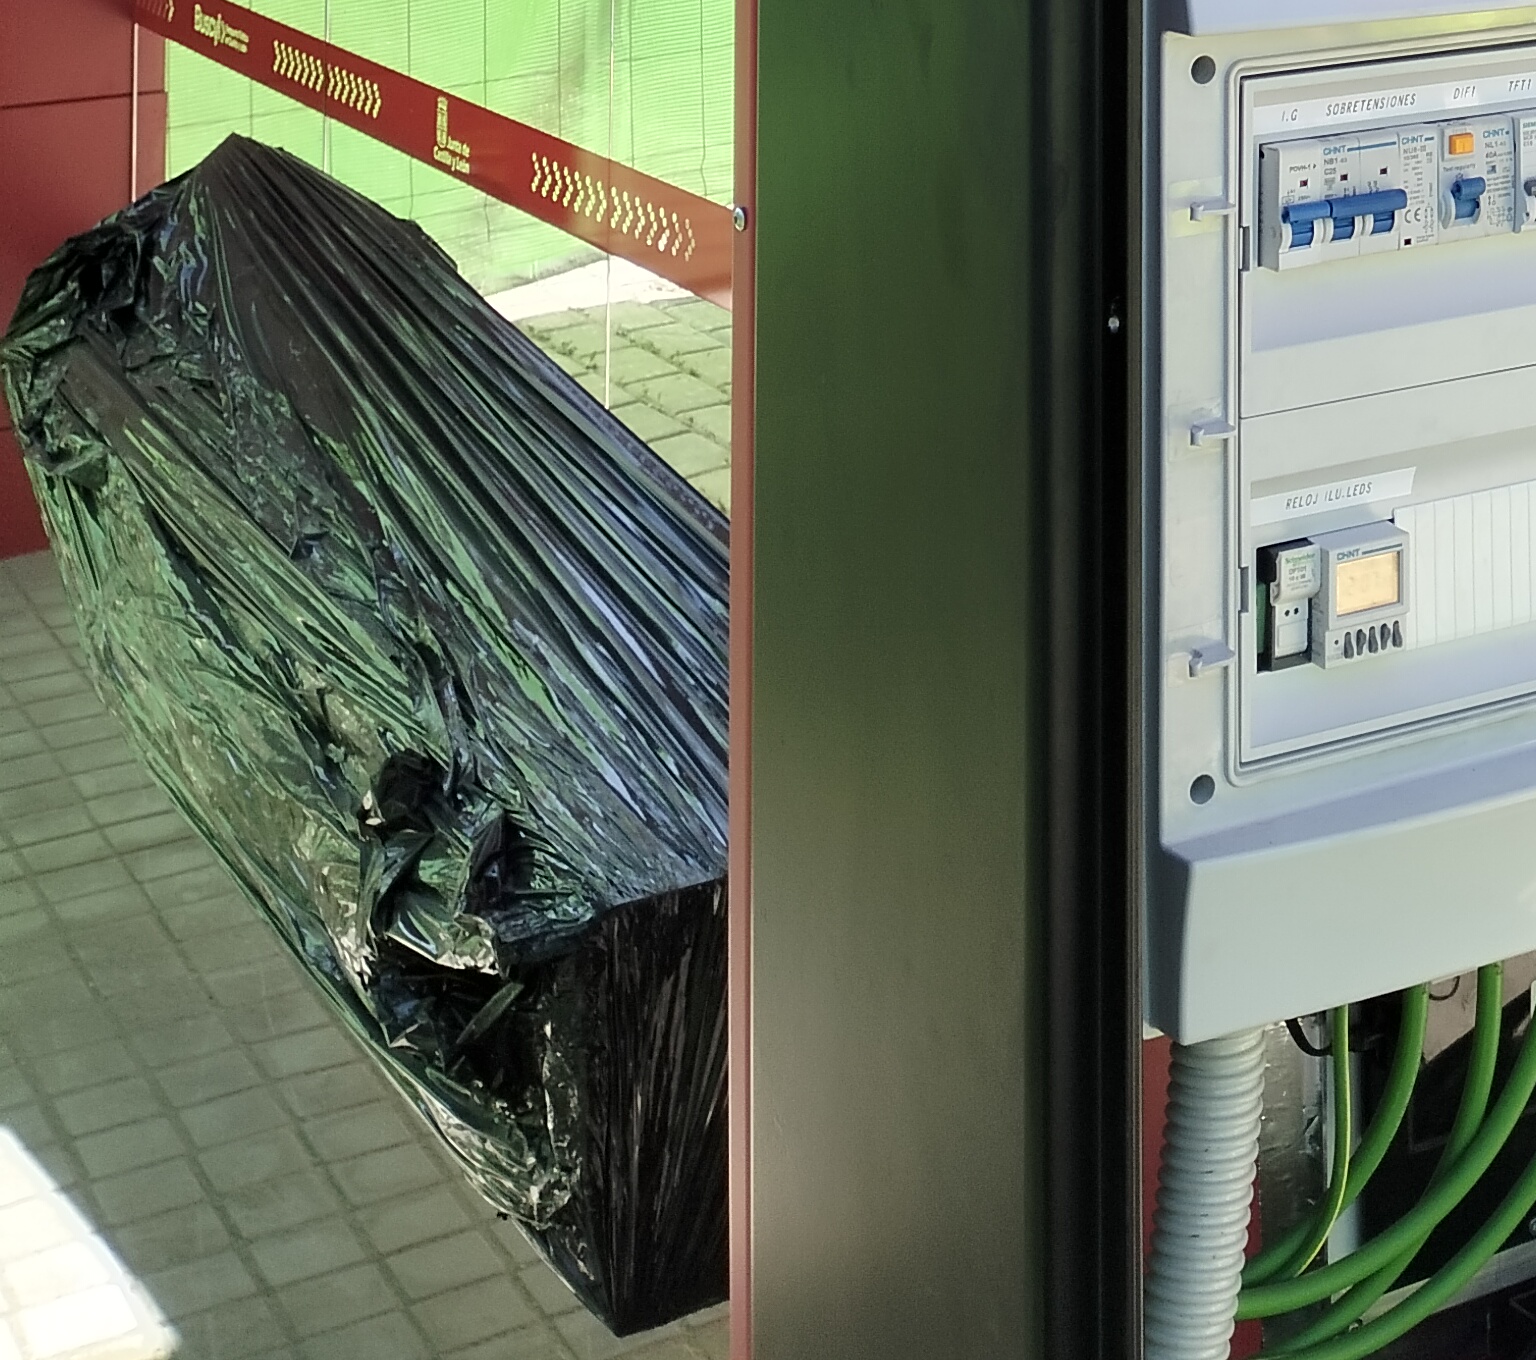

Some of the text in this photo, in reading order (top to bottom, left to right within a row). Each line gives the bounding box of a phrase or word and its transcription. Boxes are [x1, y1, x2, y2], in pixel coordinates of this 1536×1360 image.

[1326, 93, 1417, 117] SOBRETENSIONES
[1453, 85, 1476, 100] DIF1
[1508, 78, 1531, 92] TFT1
[1286, 482, 1373, 510] RELOJ ILU.LEDS
